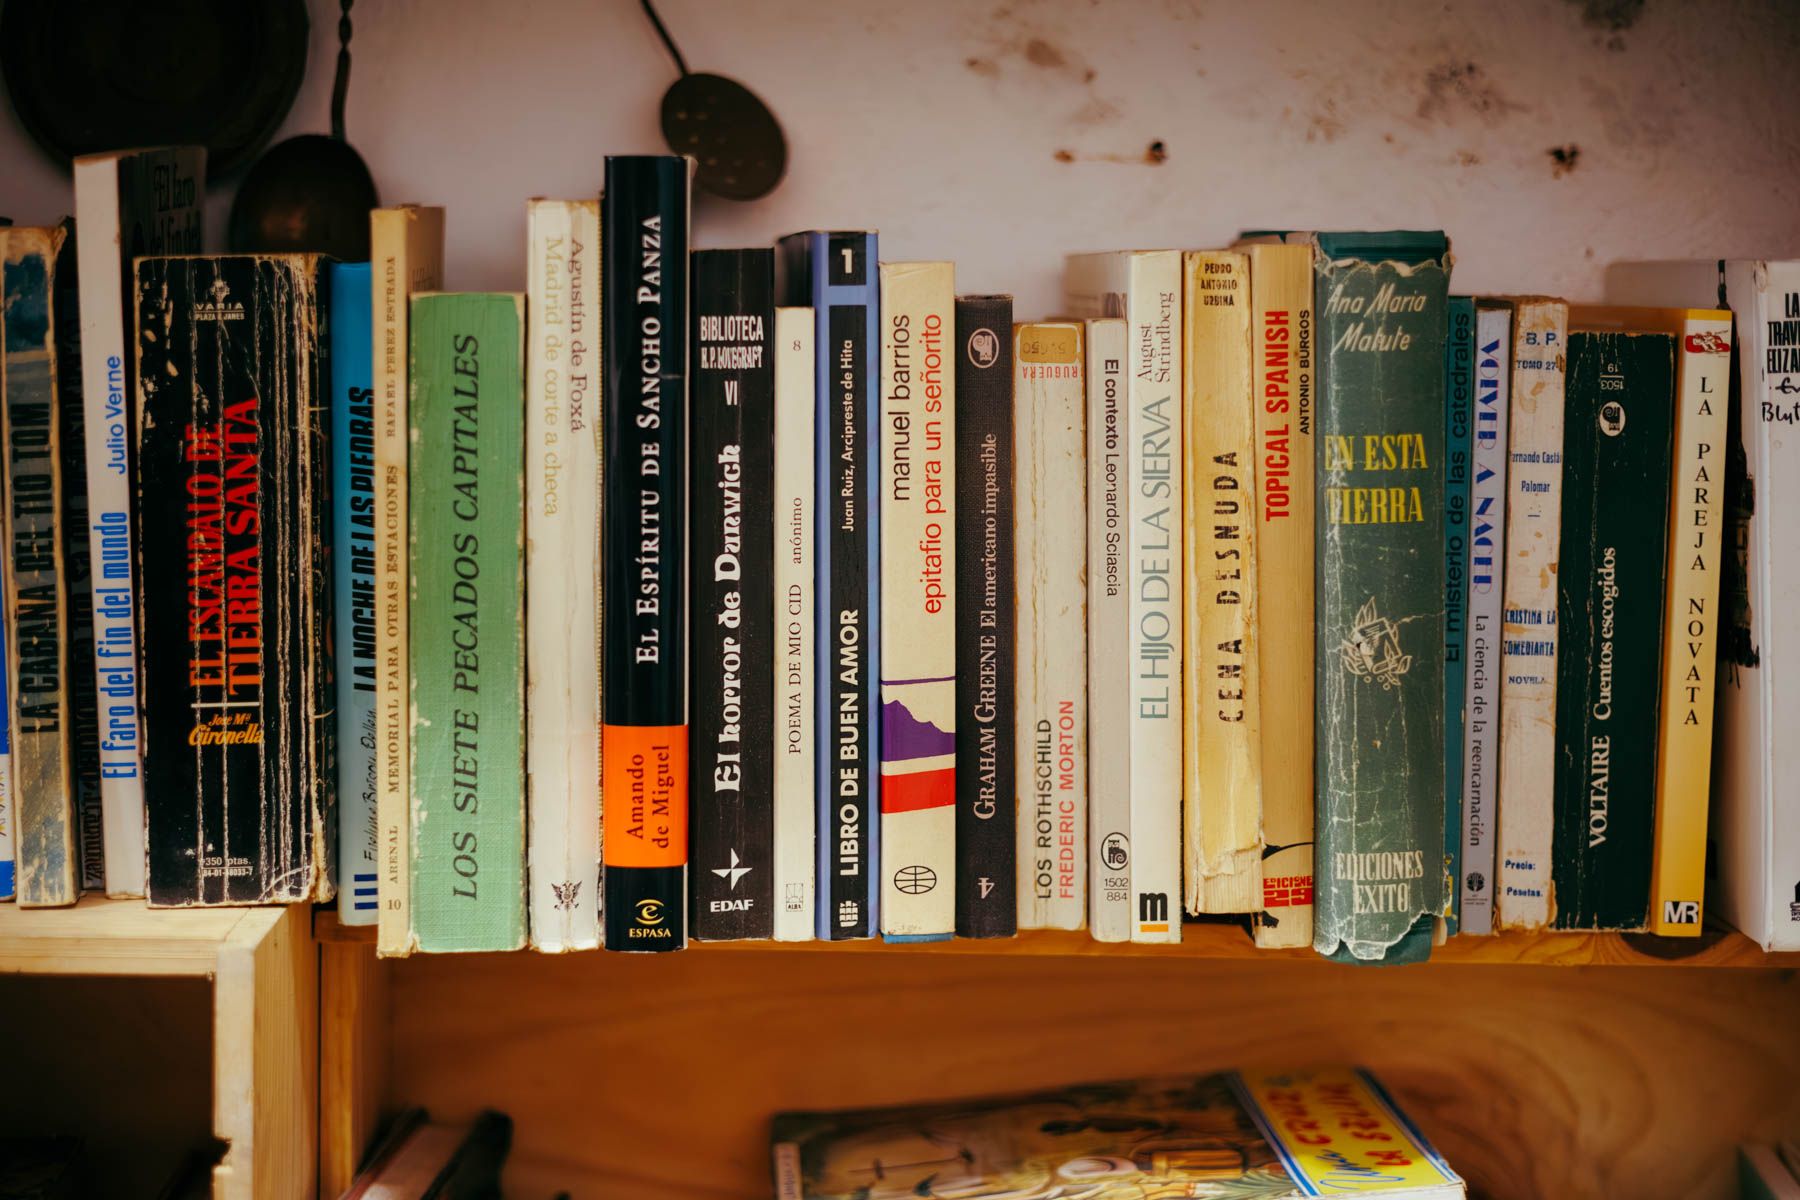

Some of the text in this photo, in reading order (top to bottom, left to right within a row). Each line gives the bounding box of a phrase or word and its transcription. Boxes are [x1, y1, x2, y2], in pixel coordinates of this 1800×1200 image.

[385, 257, 396, 322] ESTRADA
[842, 249, 853, 274] 1
[1201, 279, 1237, 290] ANTONIO
[700, 315, 764, 341] BIBLIOTECA
[1325, 283, 1364, 319] Ana
[1784, 292, 1800, 318] LA
[569, 238, 588, 434] Agustín de Foxá
[793, 341, 801, 351] 8
[1138, 324, 1156, 382] August
[1155, 292, 1175, 383] Strindberg
[1333, 322, 1412, 354] Matute
[1517, 360, 1556, 371] TOMO 27
[1525, 332, 1560, 347] B. P.
[543, 237, 564, 518] Madrid de corte a checa
[724, 380, 738, 406] VI
[1105, 359, 1119, 450] El contexto
[1299, 309, 1310, 435] ANTONIO BURGOS
[10, 403, 51, 462] TOM
[105, 355, 126, 475] Julio Verne
[347, 386, 375, 492] PIEDRAS
[386, 386, 396, 437] RAFAEL
[634, 214, 661, 665] EL ESPÍRITU DE SANCHO PANZA
[841, 339, 856, 532] Juan Ruiz, Arcipreste de Hita
[887, 314, 911, 501] manuel barrios
[1265, 310, 1290, 522] TOPICAL SPANISH
[186, 423, 221, 463] DE
[919, 314, 946, 614] epitafio para un señorito
[1324, 434, 1429, 471] EN ESTA
[350, 496, 376, 542] LAS
[1325, 487, 1425, 525] TIERRA
[1444, 312, 1470, 663] El misterio de las catedrales
[1521, 480, 1551, 493] Palomar
[15, 527, 55, 572] DEL
[224, 397, 263, 696] TIERRA SANTA
[789, 497, 802, 564] anónimo
[981, 432, 1000, 629] El americano impasible
[1105, 454, 1121, 597] Leonardo Sciascia
[1140, 395, 1174, 719] EL HIJO DE LA SIERVA
[351, 545, 376, 576] DE
[1213, 451, 1243, 722] CENA DESNUDA
[92, 512, 137, 780] El faro del fin del mundo
[351, 578, 377, 659] NOCHE
[387, 465, 399, 793] MEMORIAL PARA OTRAS ESTACIONES
[453, 334, 479, 901] LOS SIETE PECADOS CAPITALES
[714, 444, 741, 793] El horror de Dunwich
[1504, 609, 1556, 625] CRISTINA LA
[1593, 547, 1617, 721] Cuentos escogidos
[189, 650, 225, 687] EL
[353, 666, 377, 692] LA
[788, 584, 801, 754] POEMA DE MIO CID
[20, 702, 59, 733] LA
[188, 722, 265, 747] Gironella
[840, 609, 859, 876] LIBRO DE BUEN AMOR
[974, 635, 996, 821] GRAHAM GREENE
[1469, 614, 1489, 847] La ciencia de la reencarnación
[626, 753, 645, 841] Amando
[652, 744, 675, 850] de Miguel
[1037, 719, 1052, 900] LOS ROTHSCHILD
[1059, 701, 1074, 899] FREDERIC MORTON
[1589, 735, 1610, 848] VOLTAIRE
[390, 825, 398, 884] ARENAL
[1104, 877, 1128, 889] 1502
[1336, 850, 1424, 881] EDICIONES
[388, 899, 401, 910] 10
[710, 899, 754, 912] EDAF
[977, 877, 995, 900] 4
[1106, 891, 1128, 902] 884
[1664, 901, 1699, 924] MR
[628, 927, 672, 939] ESPASA
